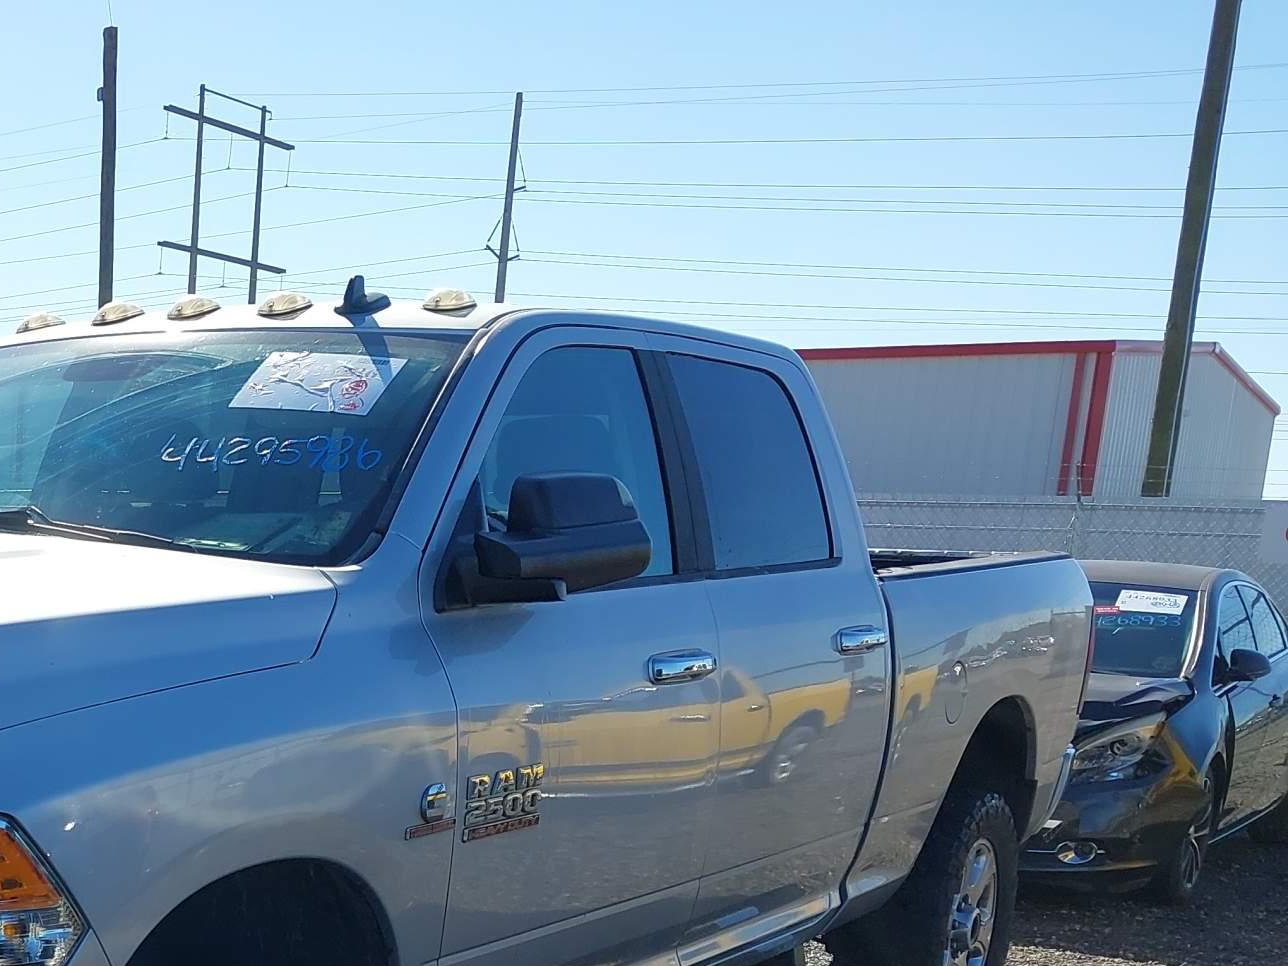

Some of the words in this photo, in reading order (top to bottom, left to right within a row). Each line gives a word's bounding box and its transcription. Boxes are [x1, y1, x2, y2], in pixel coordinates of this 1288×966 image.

[161, 434, 383, 472] 44295986
[467, 763, 544, 801] RAM
[466, 788, 542, 826] 2500
